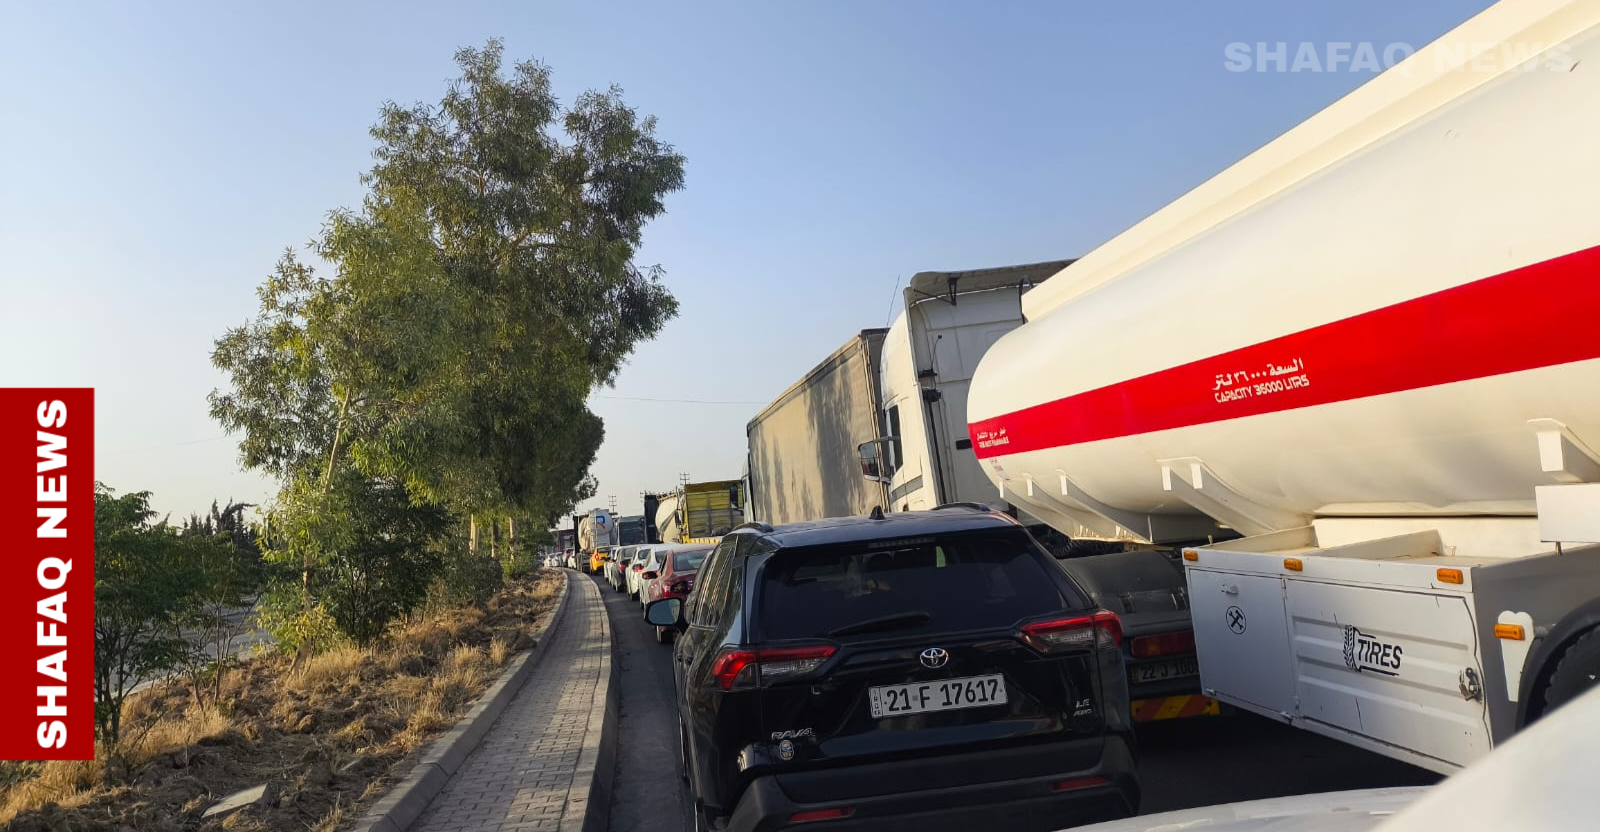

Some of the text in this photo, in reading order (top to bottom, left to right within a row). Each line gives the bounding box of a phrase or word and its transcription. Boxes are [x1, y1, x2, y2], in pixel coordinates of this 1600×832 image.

[1267, 357, 1304, 376] السعة
[1212, 373, 1233, 390] لتر
[1215, 386, 1252, 403] CAPACITY
[1253, 380, 1283, 396] 36000
[1358, 638, 1403, 669] TIRES
[1141, 665, 1156, 679] 22
[887, 679, 998, 711] 21 F 17617
[1076, 699, 1090, 708] LE
[771, 727, 816, 739] RAV4
